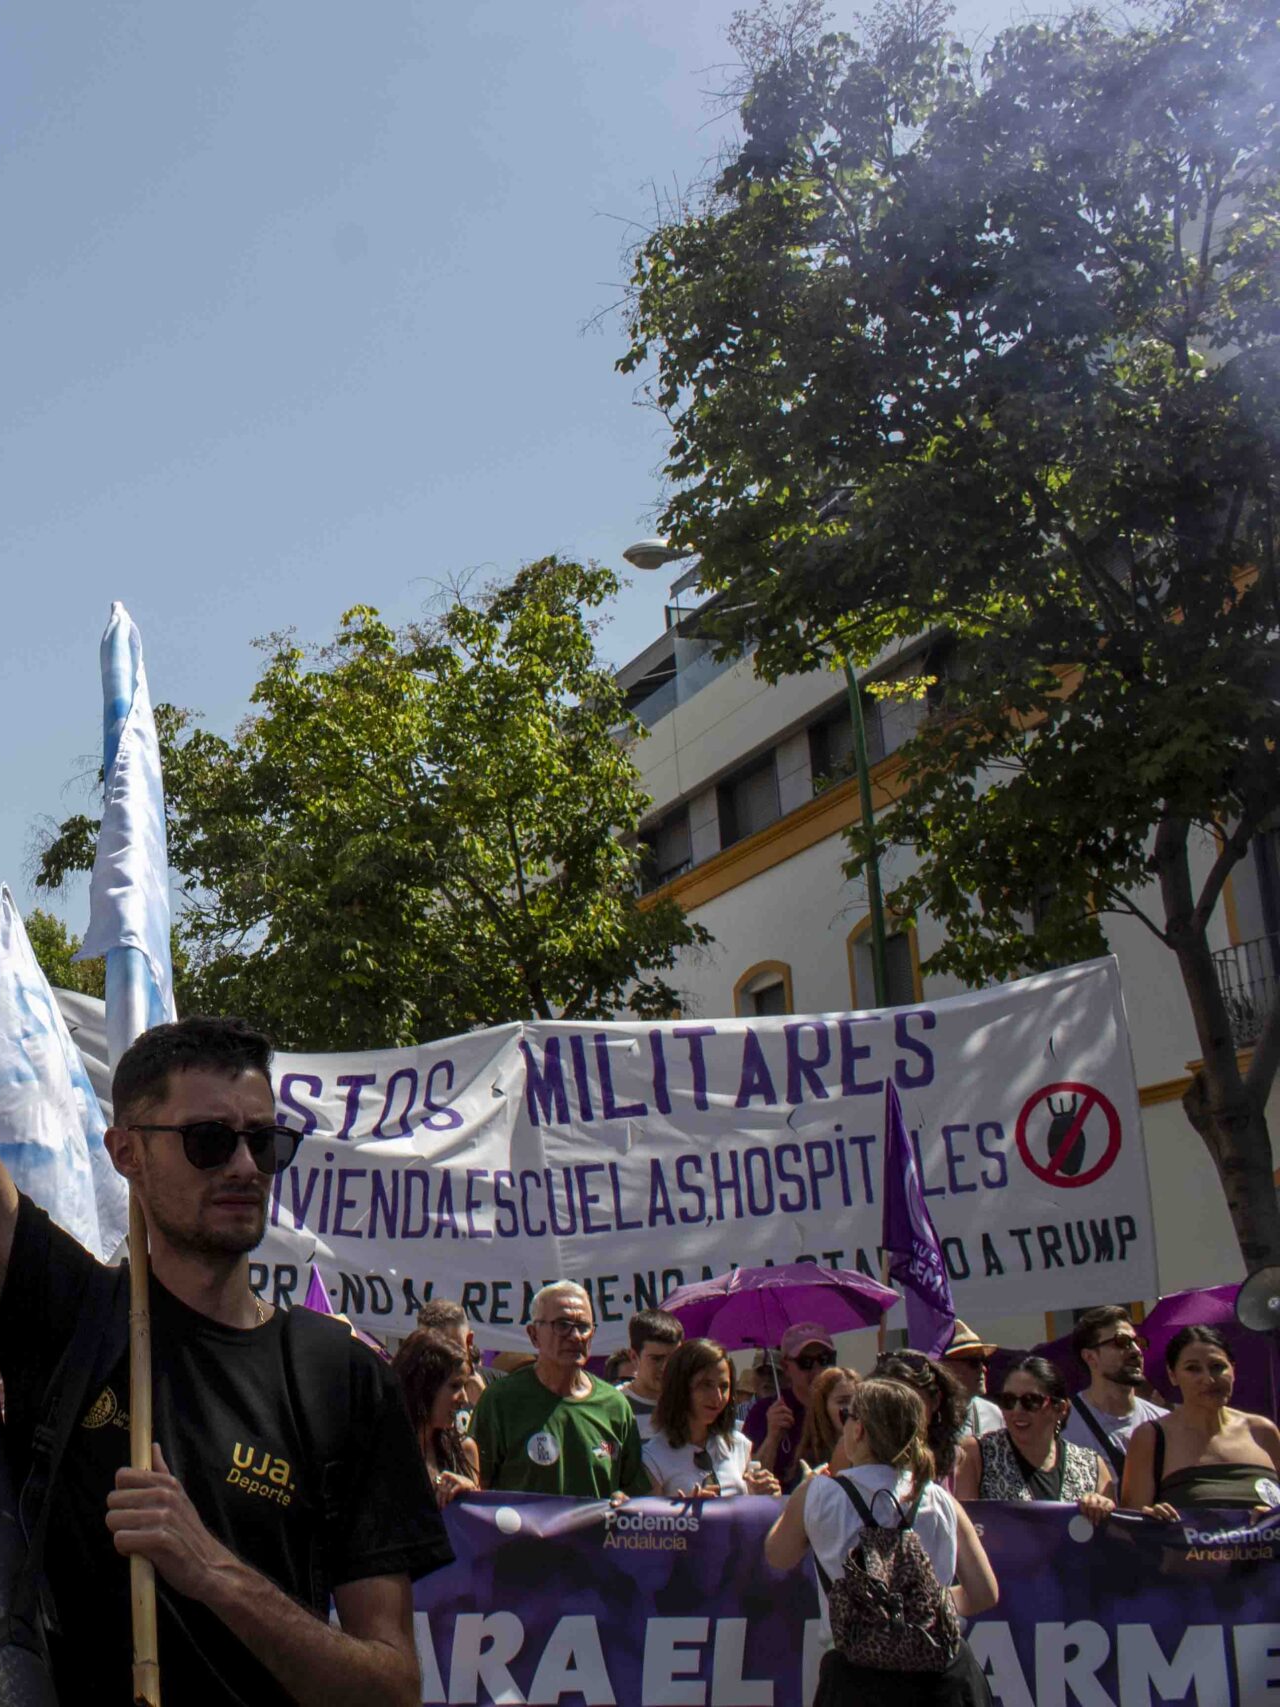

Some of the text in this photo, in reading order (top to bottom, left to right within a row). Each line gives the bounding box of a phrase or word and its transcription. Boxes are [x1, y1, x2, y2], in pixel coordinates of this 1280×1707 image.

[275, 1010, 937, 1141] STOS MILITARES
[710, 1121, 1009, 1221] HOSPITLES
[940, 1236, 971, 1281] O
[981, 1232, 1005, 1277] A
[1008, 1214, 1138, 1272] TRUMP
[226, 1467, 292, 1506] Deporte
[602, 1531, 688, 1551] Andalucía
[604, 1511, 700, 1533] Podemos
[641, 1616, 775, 1706] EL
